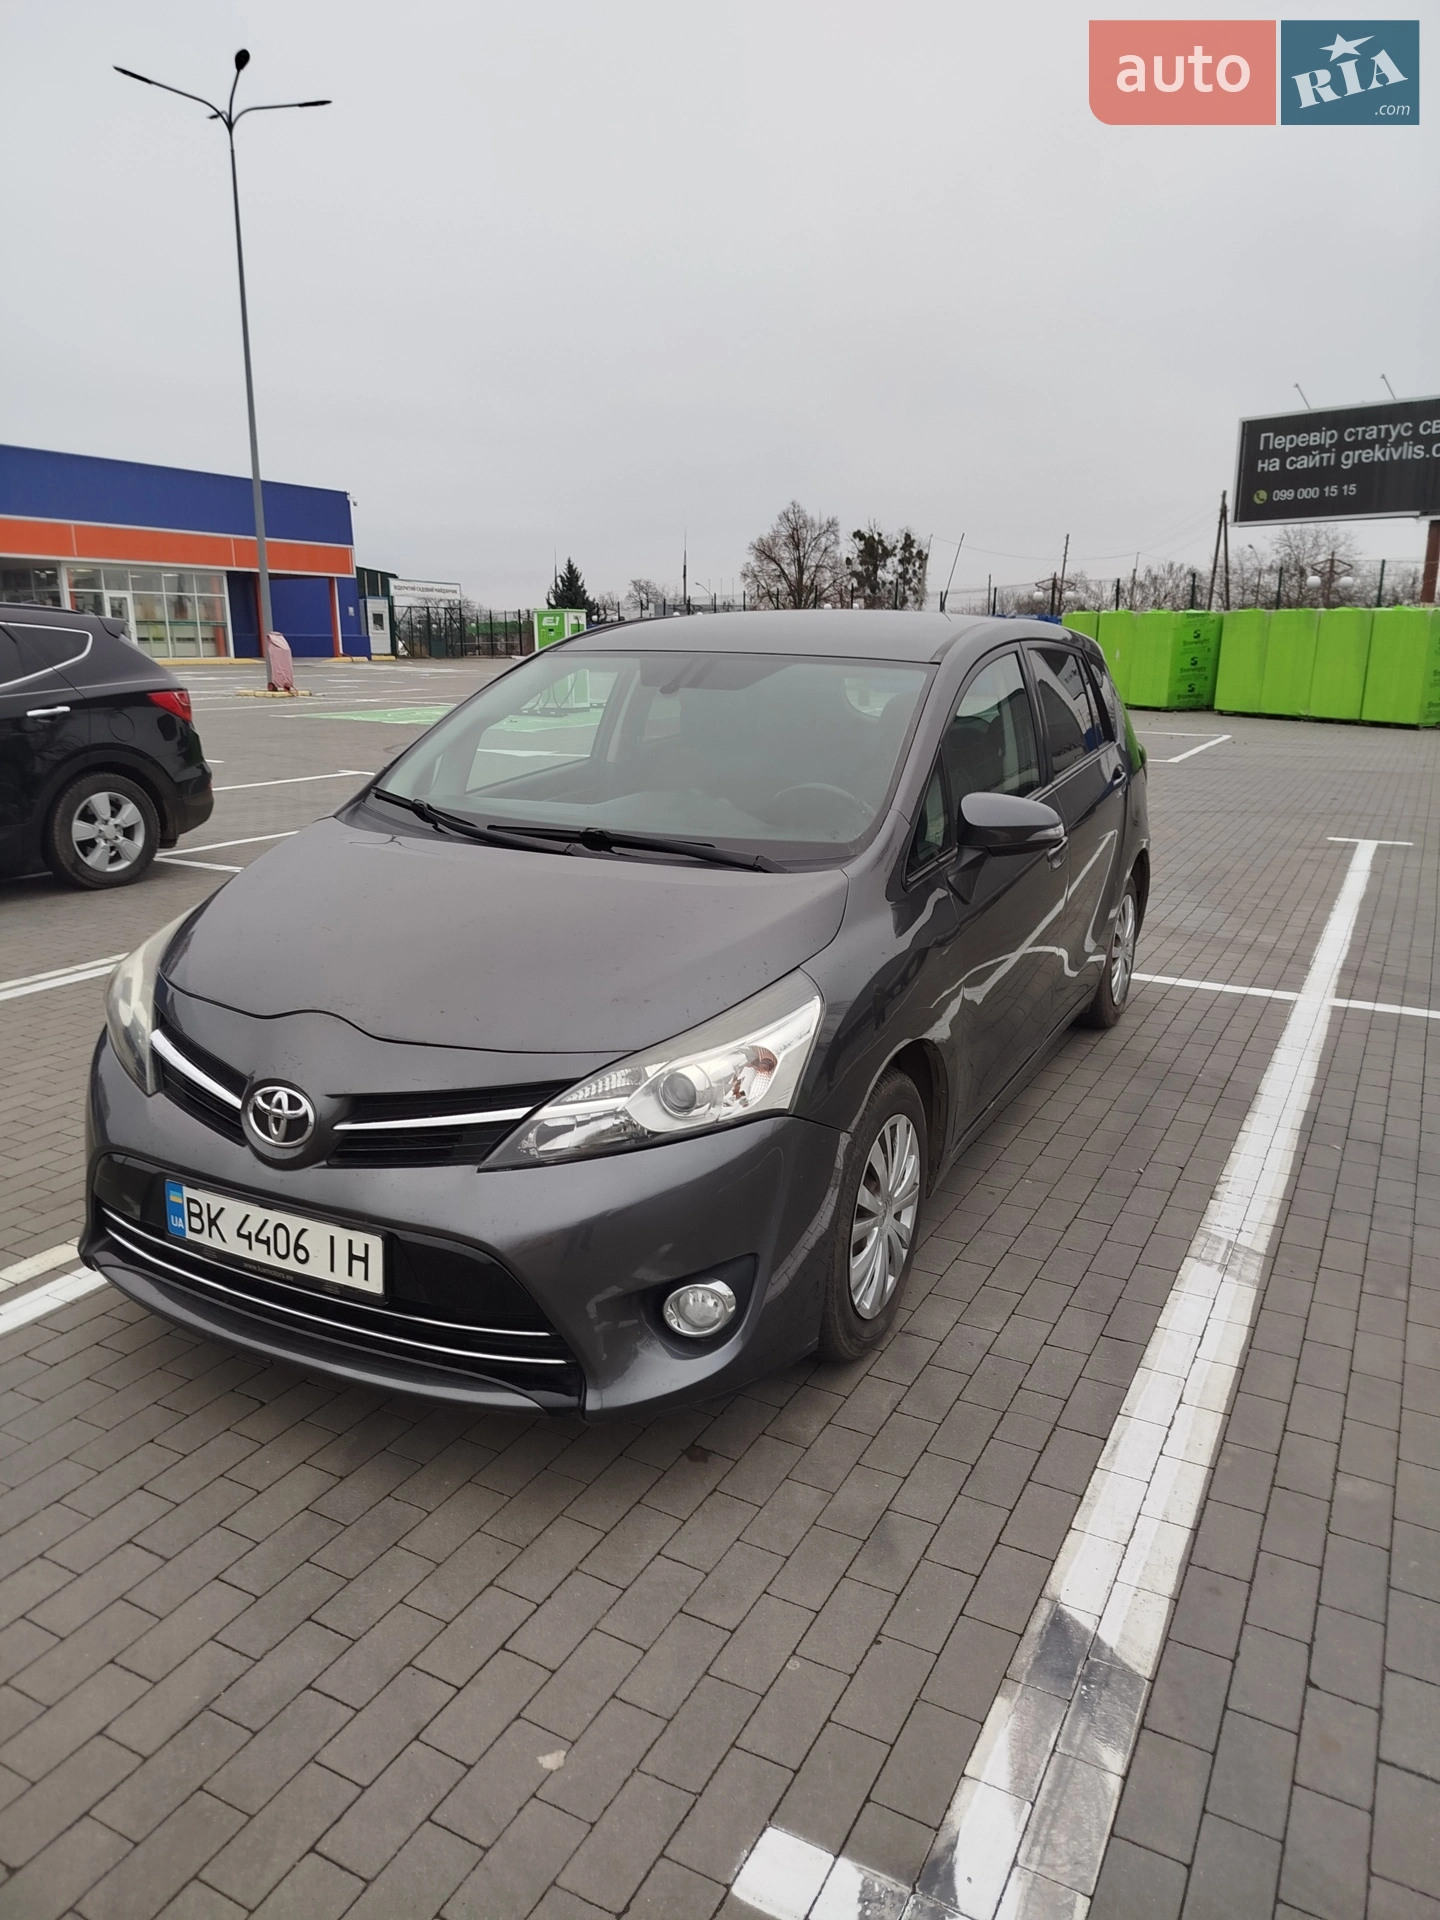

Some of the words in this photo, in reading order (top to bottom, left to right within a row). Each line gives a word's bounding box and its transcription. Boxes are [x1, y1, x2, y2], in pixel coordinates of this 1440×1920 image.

[1259, 427, 1338, 452] Перевір
[1344, 421, 1413, 443] статус
[1257, 457, 1280, 472] на
[1285, 448, 1336, 470] сайті
[1272, 489, 1295, 501] 099
[1297, 487, 1320, 500] 000
[1323, 485, 1338, 497] 15
[1341, 484, 1357, 495] 15
[170, 1215, 185, 1229] UA
[186, 1196, 228, 1244] BK
[236, 1213, 310, 1265] 4406
[329, 1235, 370, 1282] IH
